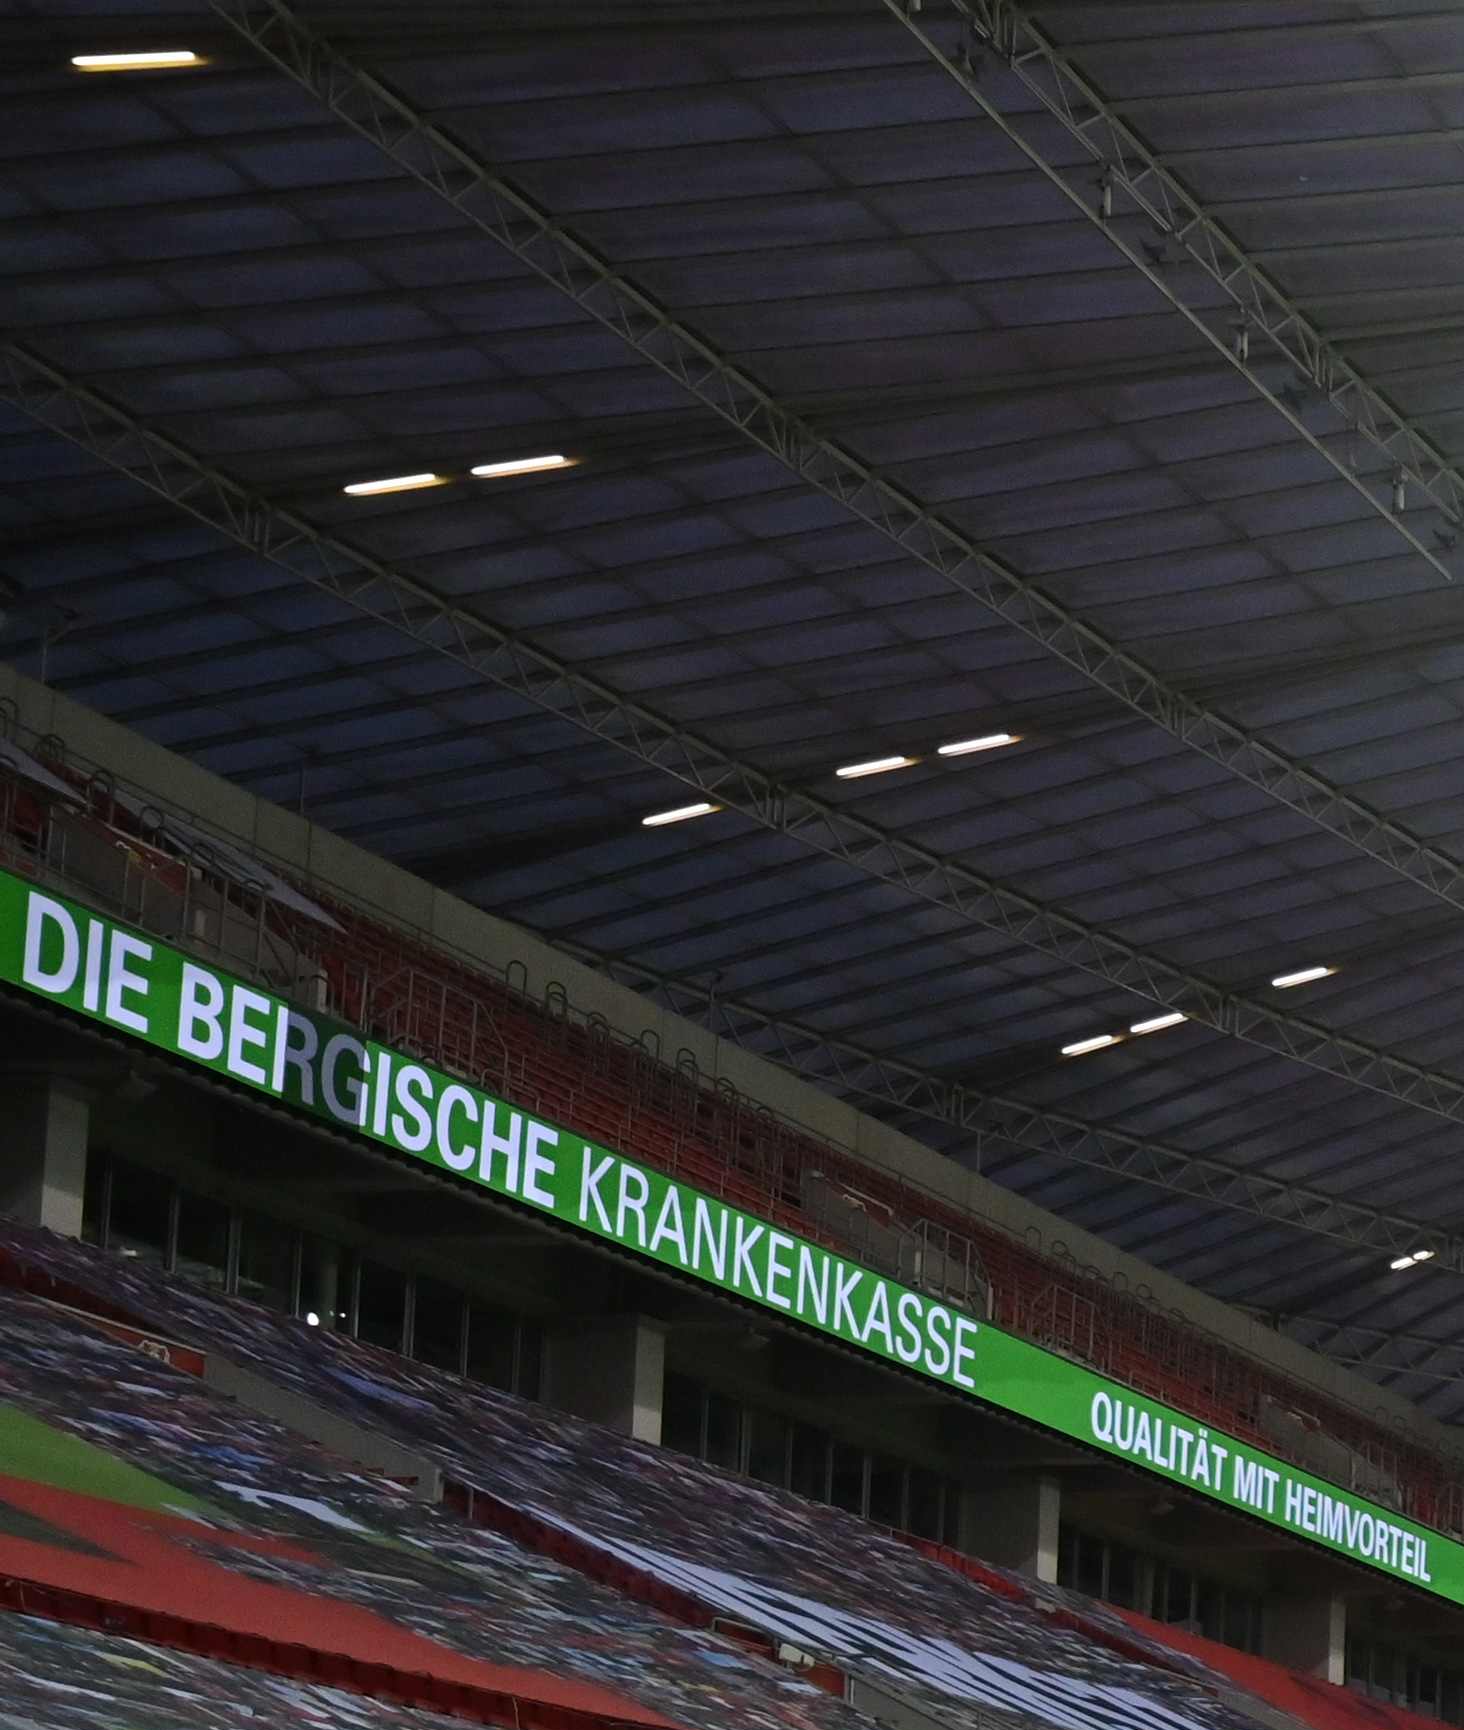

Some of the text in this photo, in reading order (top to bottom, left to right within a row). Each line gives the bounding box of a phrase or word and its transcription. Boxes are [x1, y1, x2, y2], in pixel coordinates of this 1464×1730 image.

[22, 890, 977, 1390] DIE BERGISCHE KRANKENKASSE
[1091, 1391, 1431, 1584] QUALITÄT MIT HEIMVORTEIL
